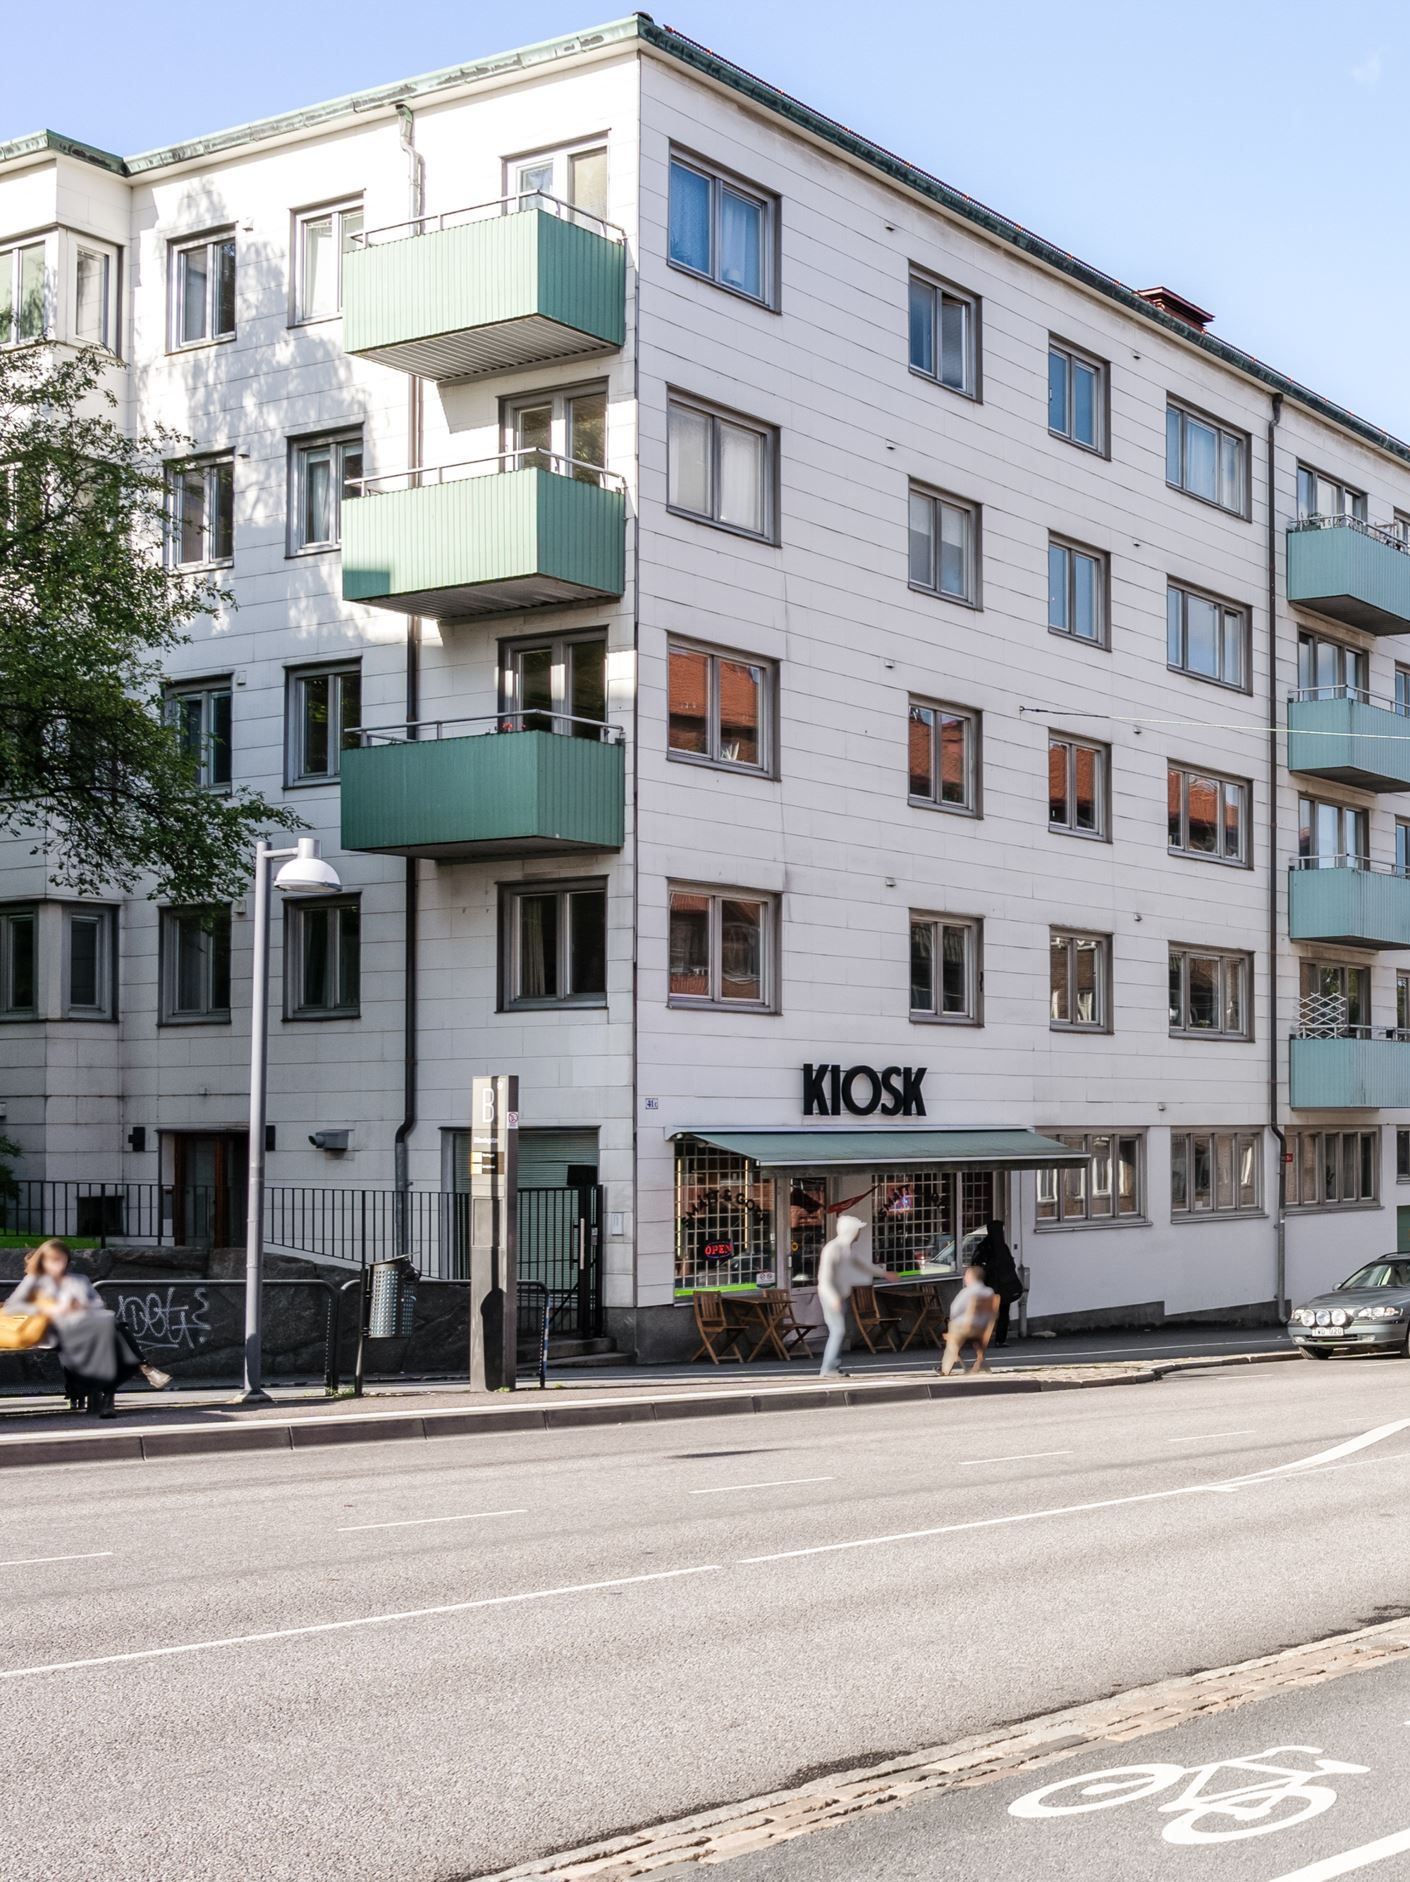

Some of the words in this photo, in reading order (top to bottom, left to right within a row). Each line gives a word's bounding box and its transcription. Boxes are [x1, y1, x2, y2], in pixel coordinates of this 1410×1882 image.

[482, 1087, 495, 1123] B
[803, 1063, 928, 1117] KIOSK
[704, 1244, 733, 1256] OPEN
